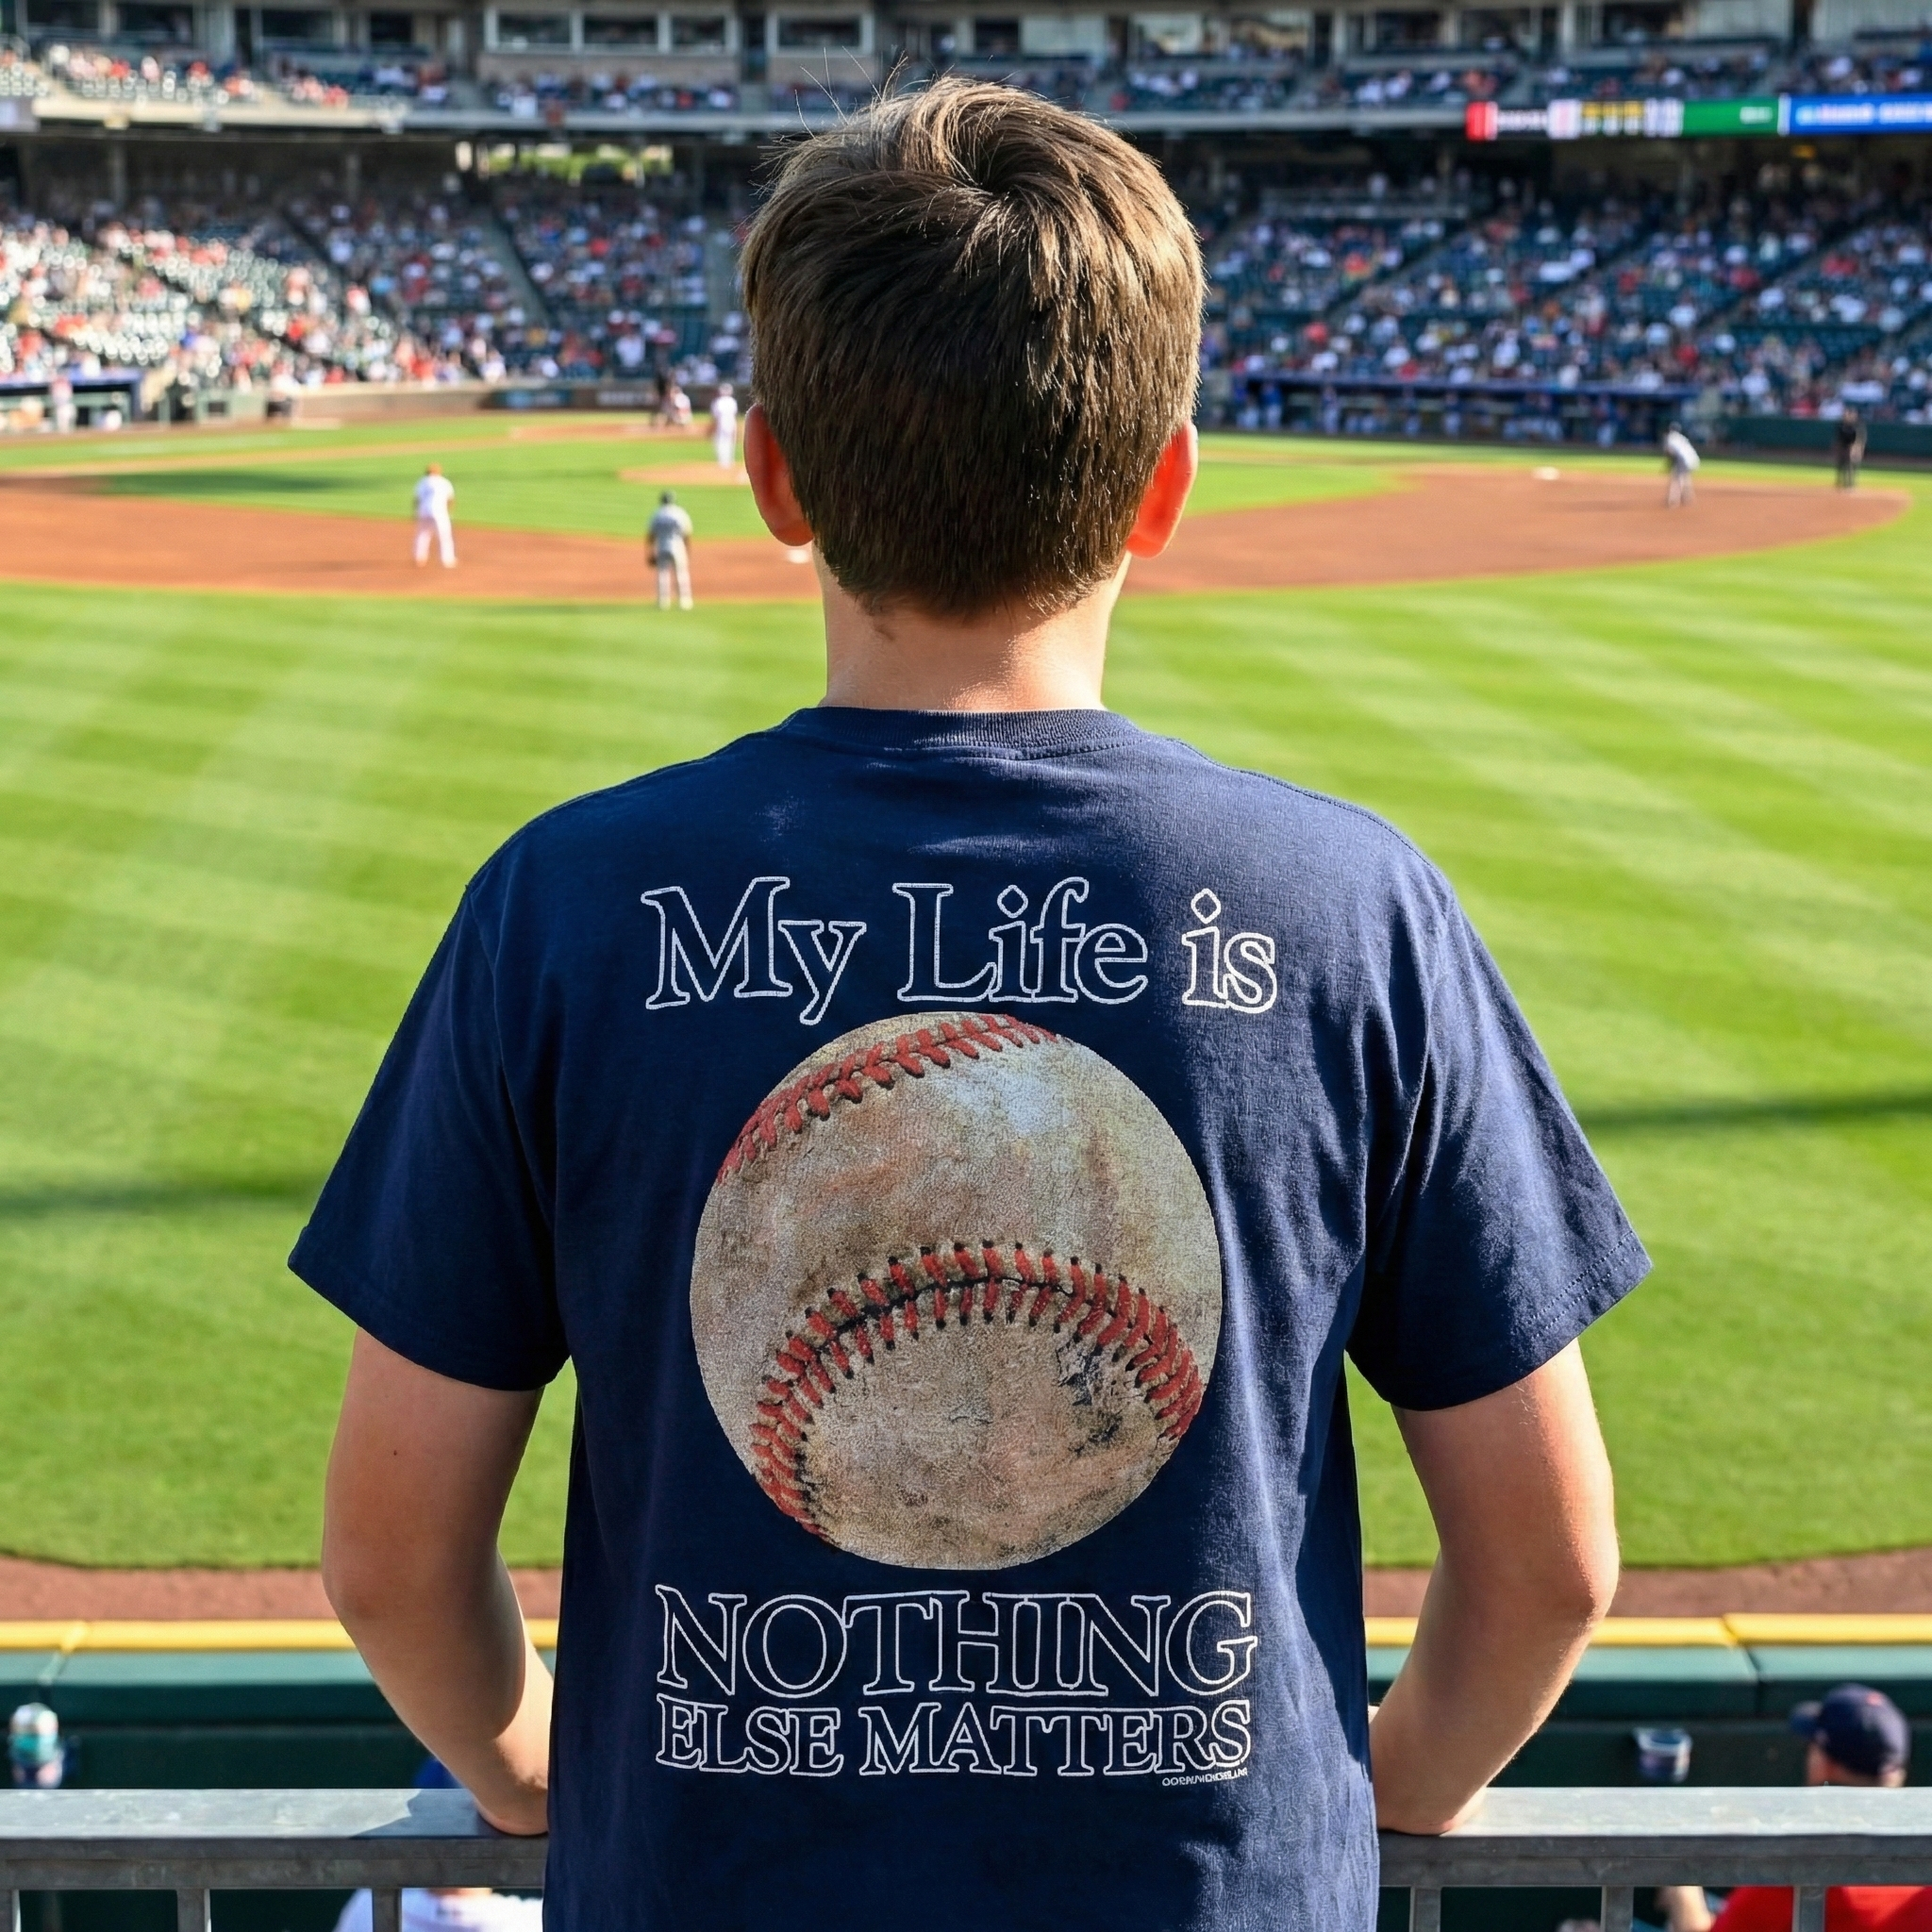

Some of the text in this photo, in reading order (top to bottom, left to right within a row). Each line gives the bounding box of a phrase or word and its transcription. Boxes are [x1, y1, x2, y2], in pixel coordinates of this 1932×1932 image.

[641, 876, 1277, 1025] My Life is
[656, 1585, 1257, 1698] NOTHING
[656, 1693, 1252, 1776] ELSE MATTERS
